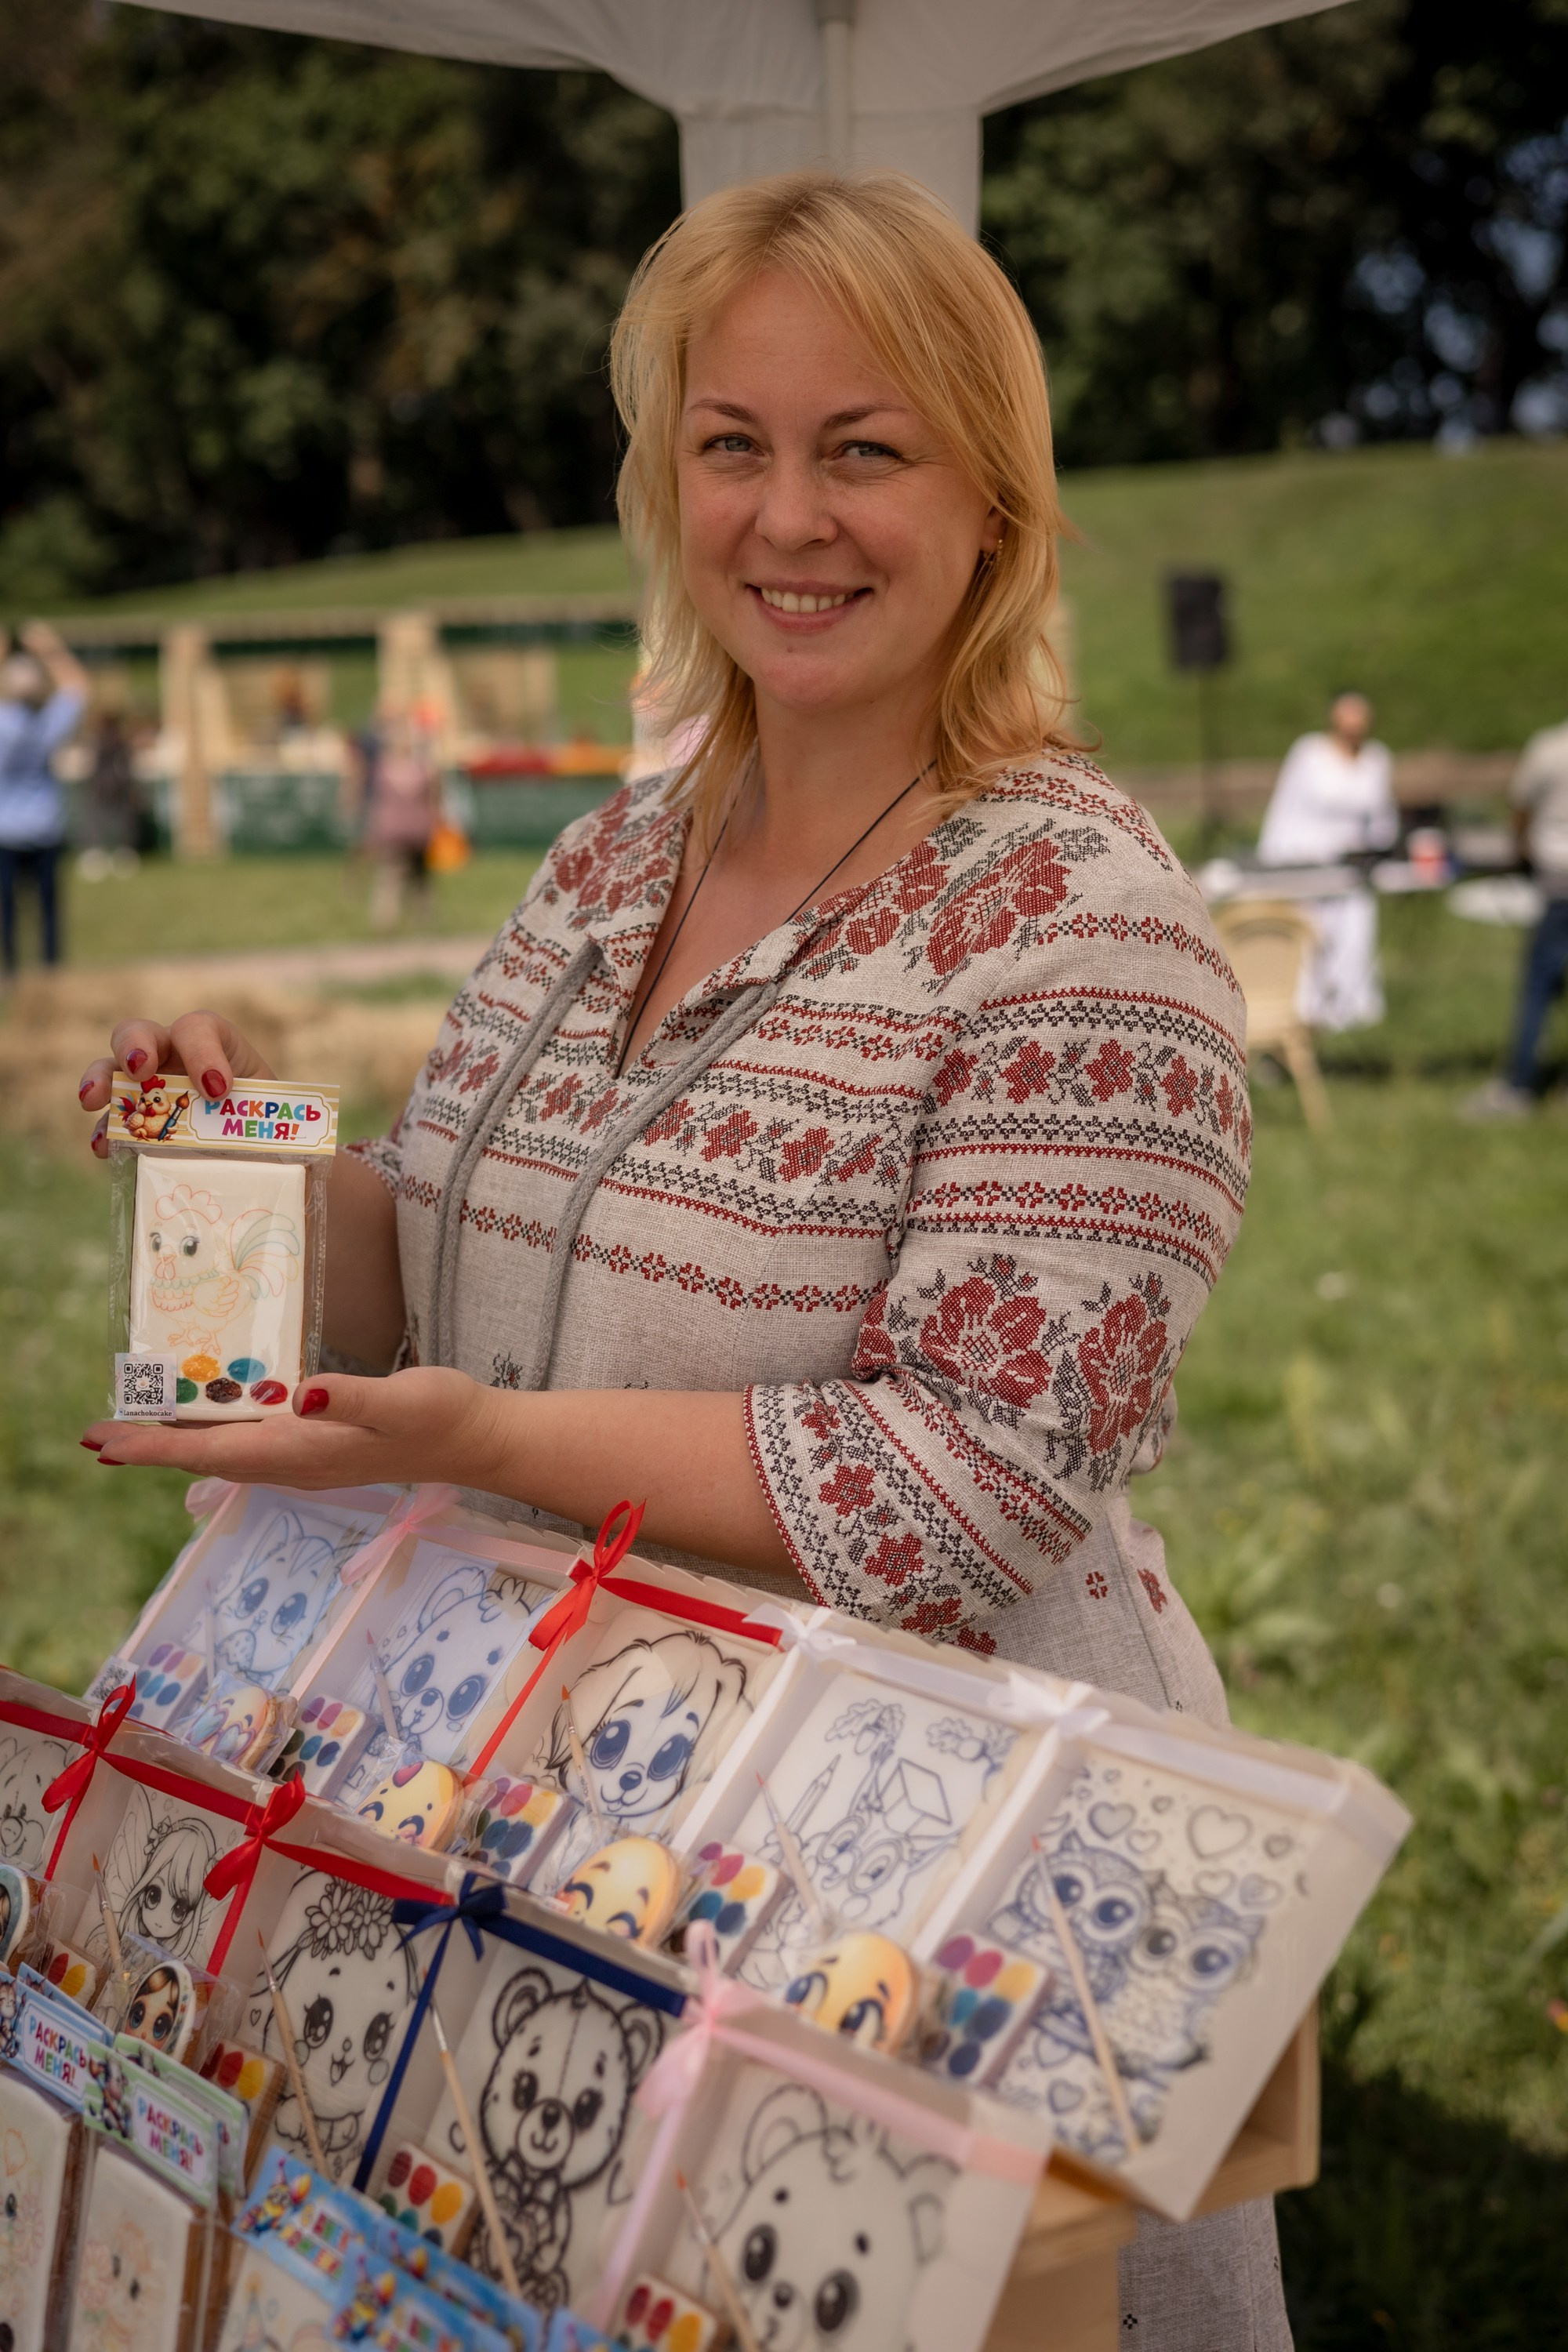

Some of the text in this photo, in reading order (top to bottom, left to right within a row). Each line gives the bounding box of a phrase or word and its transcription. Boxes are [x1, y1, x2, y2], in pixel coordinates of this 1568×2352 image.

[205, 1098, 321, 1122] РАСКРАСЬ
[222, 1118, 299, 1141] МЕНЯ!
[29, 2015, 86, 2068] РАСКРАСЬ
[34, 2045, 76, 2086] МЕНЯ!
[138, 2096, 204, 2156] РАСКРАСЬ
[150, 2128, 193, 2173] МЕНЯ!
